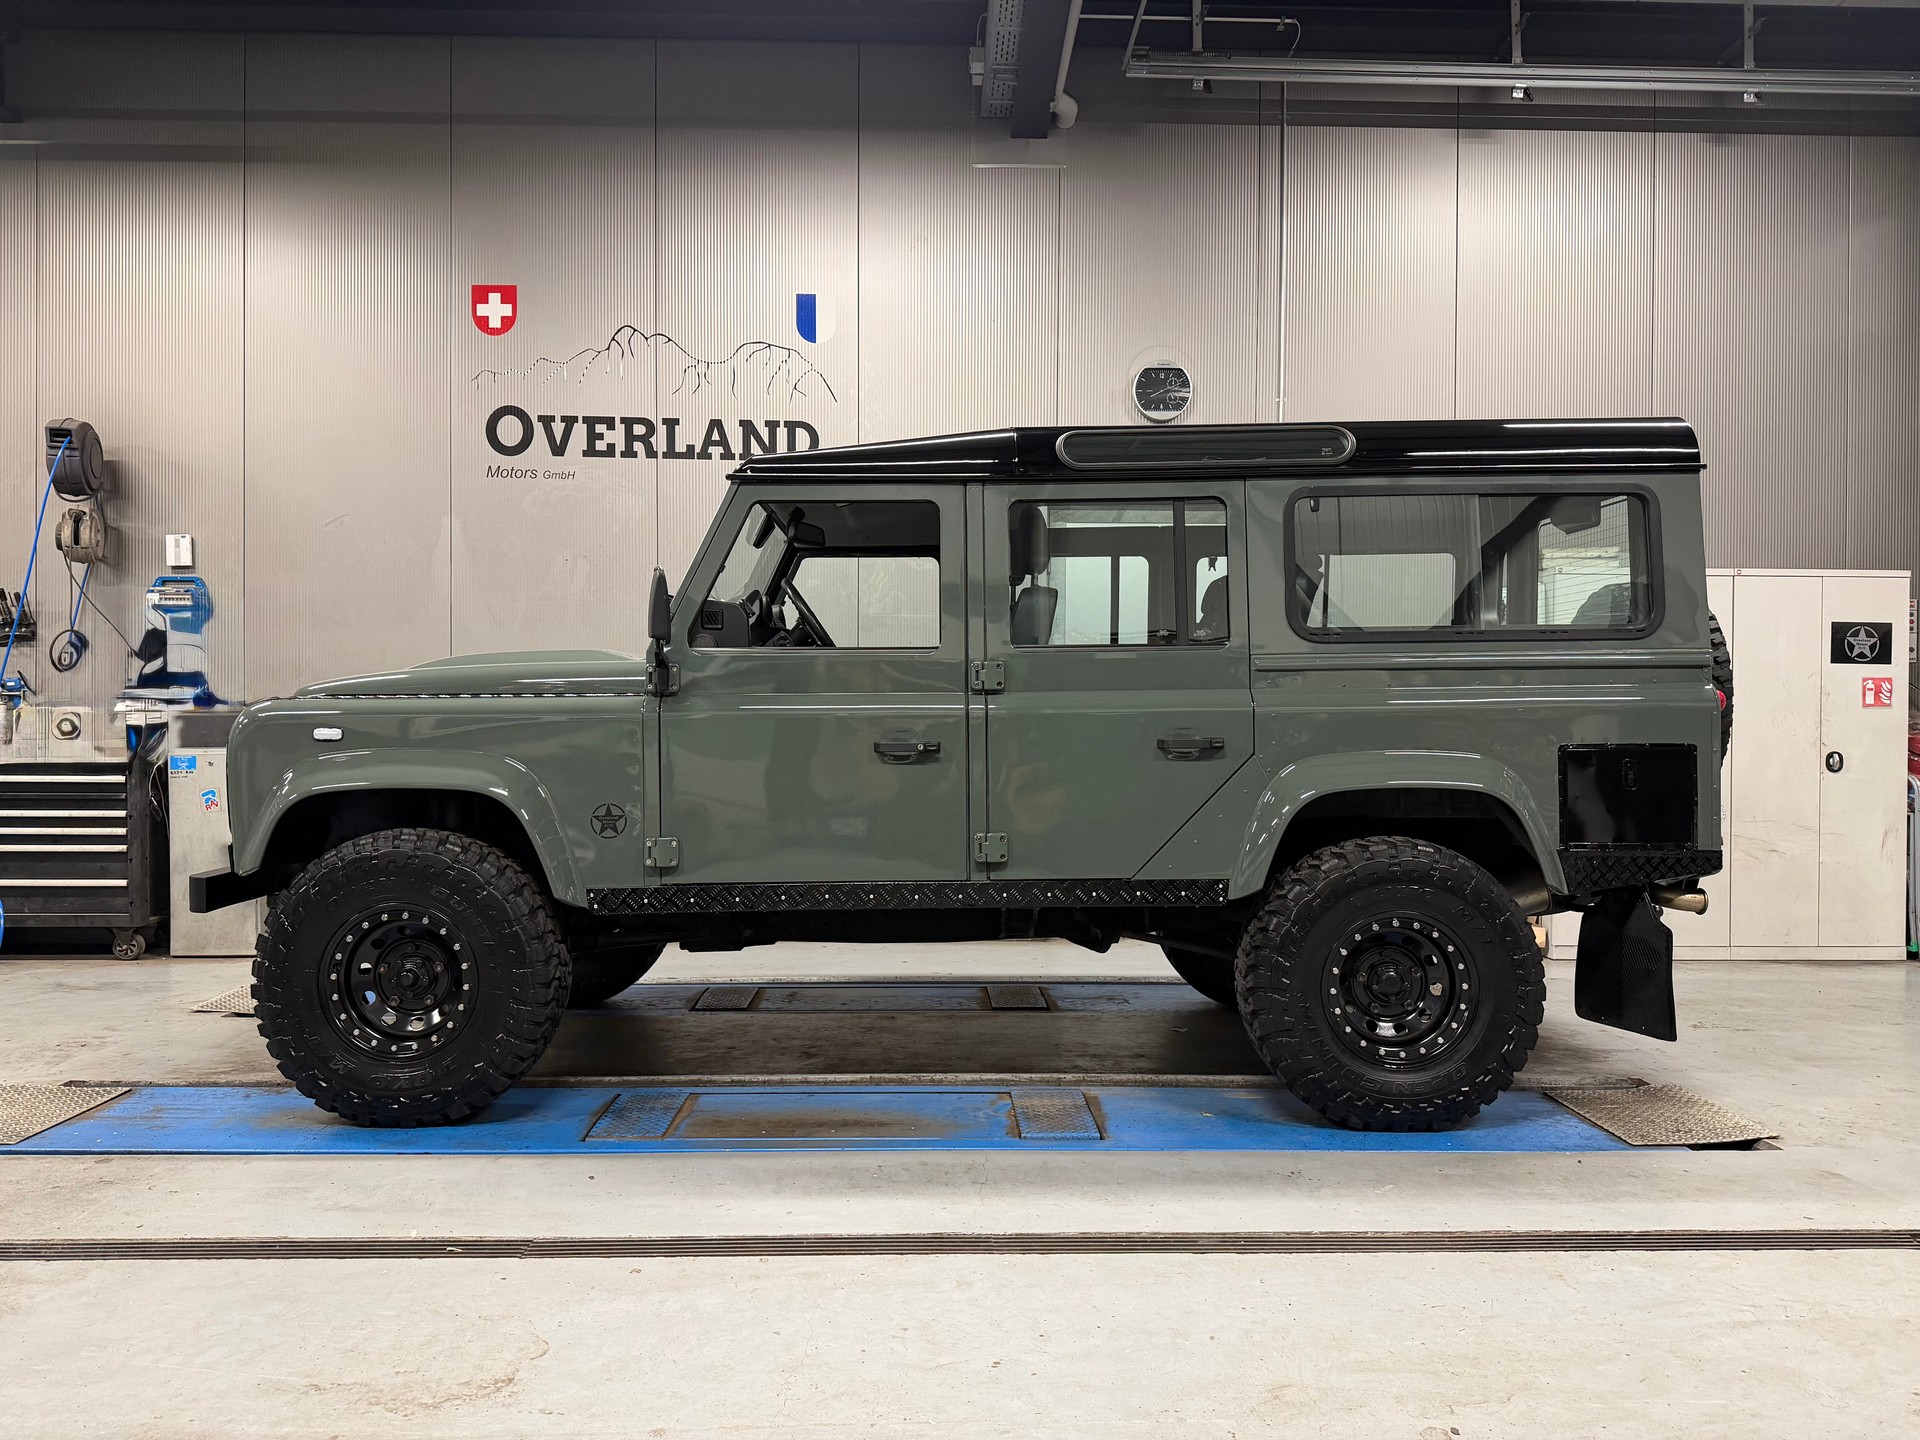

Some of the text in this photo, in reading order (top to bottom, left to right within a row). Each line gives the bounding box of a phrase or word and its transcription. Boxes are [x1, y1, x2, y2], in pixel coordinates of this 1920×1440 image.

[485, 404, 820, 461] OVERLAND
[486, 465, 576, 480] Motors GmbH
